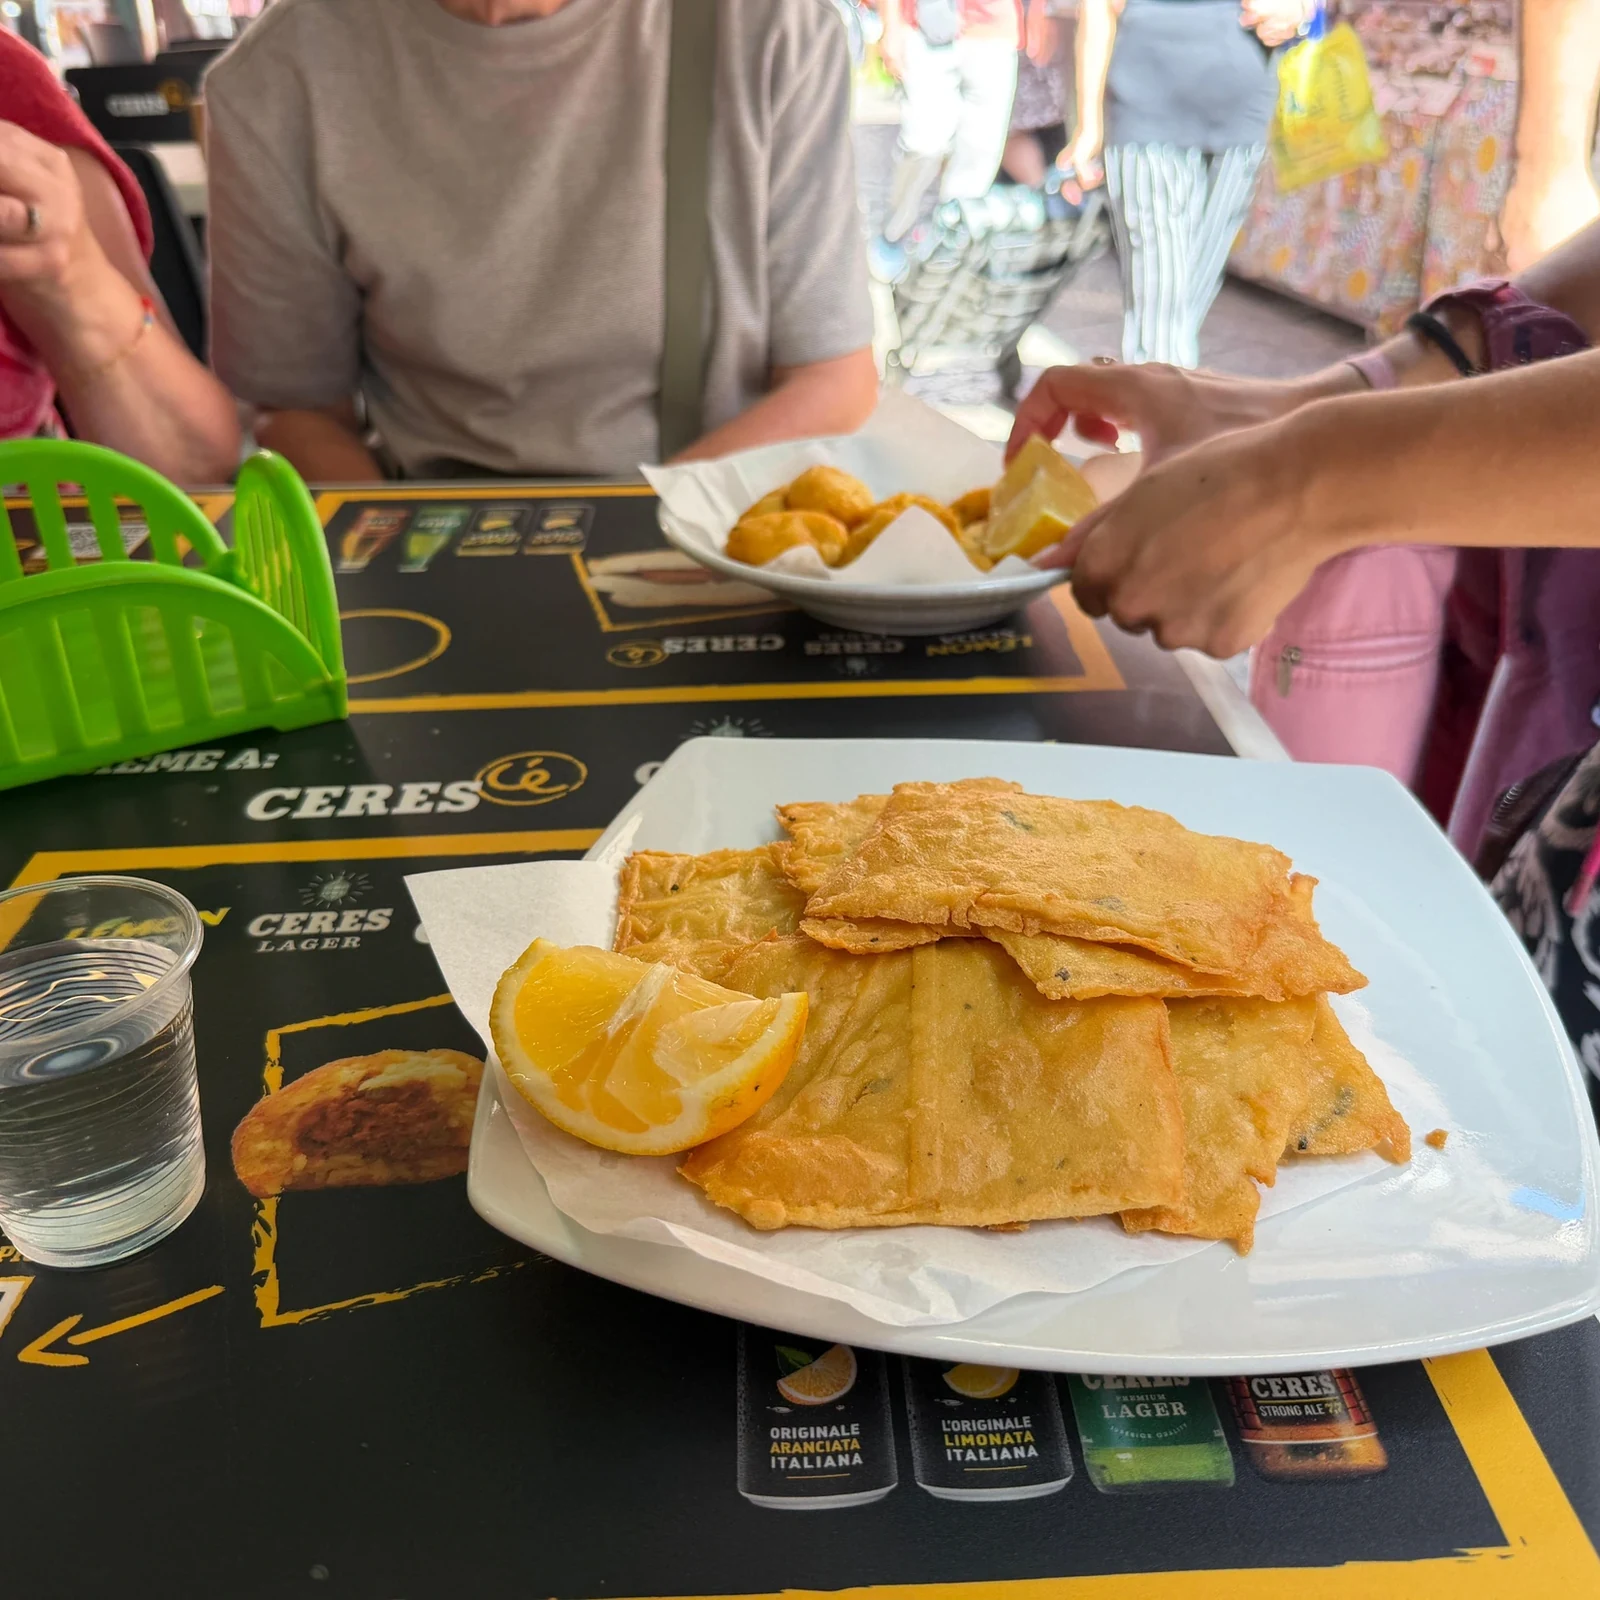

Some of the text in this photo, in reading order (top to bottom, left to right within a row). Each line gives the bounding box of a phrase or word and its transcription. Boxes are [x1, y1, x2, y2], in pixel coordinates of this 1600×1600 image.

[663, 634, 785, 654] CERES
[224, 748, 280, 770] A:
[246, 780, 483, 821] CERES
[249, 908, 393, 937] CERES
[257, 936, 361, 953] LAGER
[1251, 1374, 1336, 1398] CERES
[1116, 1393, 1166, 1401] PREMIUM
[1101, 1401, 1187, 1419] LAGER
[1259, 1404, 1302, 1417] STRONG
[1304, 1403, 1325, 1415] ALE
[770, 1423, 860, 1440] ORIGINALE
[942, 1415, 1032, 1433] L'ORIGINALE
[770, 1438, 861, 1455] ARANCIATA
[944, 1430, 1034, 1447] LIMONATA
[771, 1453, 864, 1470] ITALIANA
[946, 1445, 1038, 1462] ITALIANA
